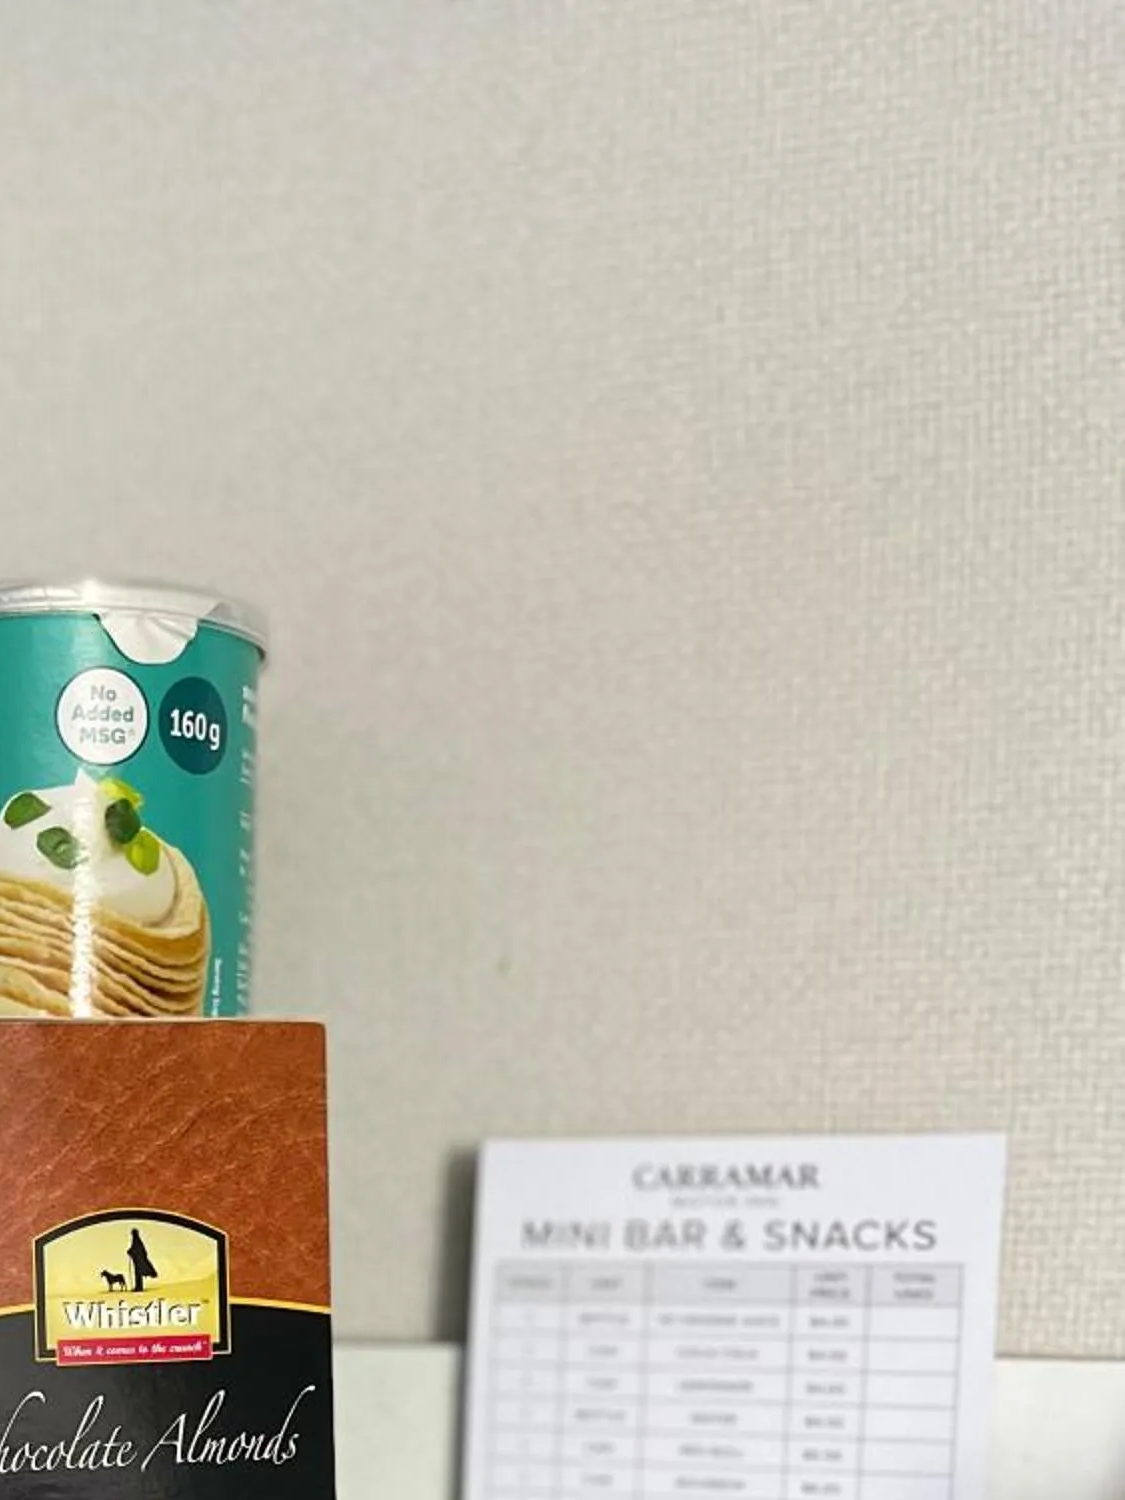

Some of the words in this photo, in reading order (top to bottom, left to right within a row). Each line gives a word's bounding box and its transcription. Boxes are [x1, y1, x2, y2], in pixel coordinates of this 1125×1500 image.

[90, 685, 117, 702] No
[71, 705, 134, 722] Added
[631, 1164, 821, 1191] CARRAMAR
[520, 1219, 611, 1250] MINI
[623, 1219, 707, 1250] BAR
[719, 1219, 748, 1251] &
[763, 1220, 938, 1251] SNACKS
[62, 1298, 202, 1329] Whistler
[141, 1385, 316, 1473] Almonds
